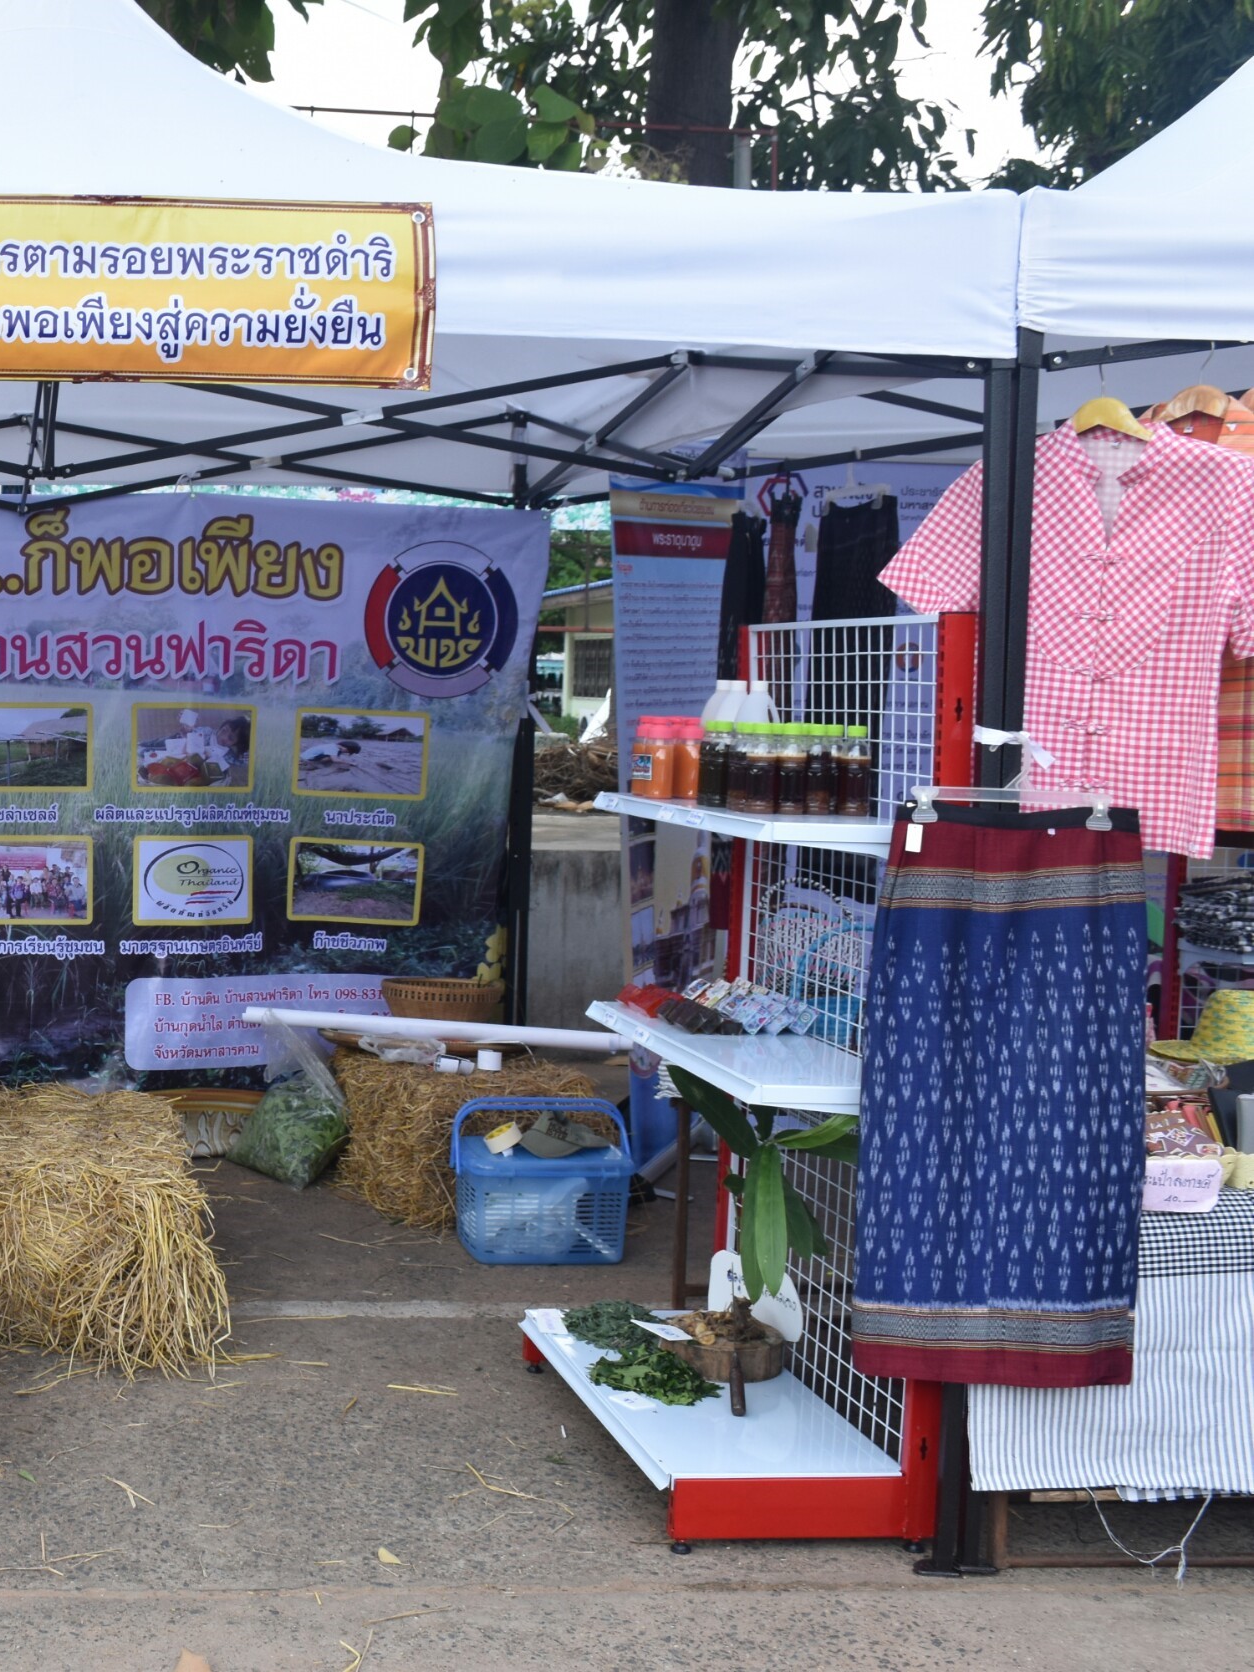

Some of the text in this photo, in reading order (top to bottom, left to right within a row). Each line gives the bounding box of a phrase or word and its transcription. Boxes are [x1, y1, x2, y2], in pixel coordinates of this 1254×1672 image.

[94, 803, 290, 827] ผลิตและแปรรูปผลิตภัณฑ์ชุมชน
[324, 809, 396, 826] นาประณีต
[177, 861, 238, 876] Organic
[179, 878, 240, 886] Thailand
[120, 932, 262, 958] มาตรฐานเกษตรอินทรีย์
[155, 984, 384, 1006] FB. บ้านดิน บ้านสวนฟาริดา โทร 098-831
[154, 1014, 222, 1037] บ้านกุดน้ำใส
[154, 1044, 259, 1060] จังหวัดมหาสารคาม
